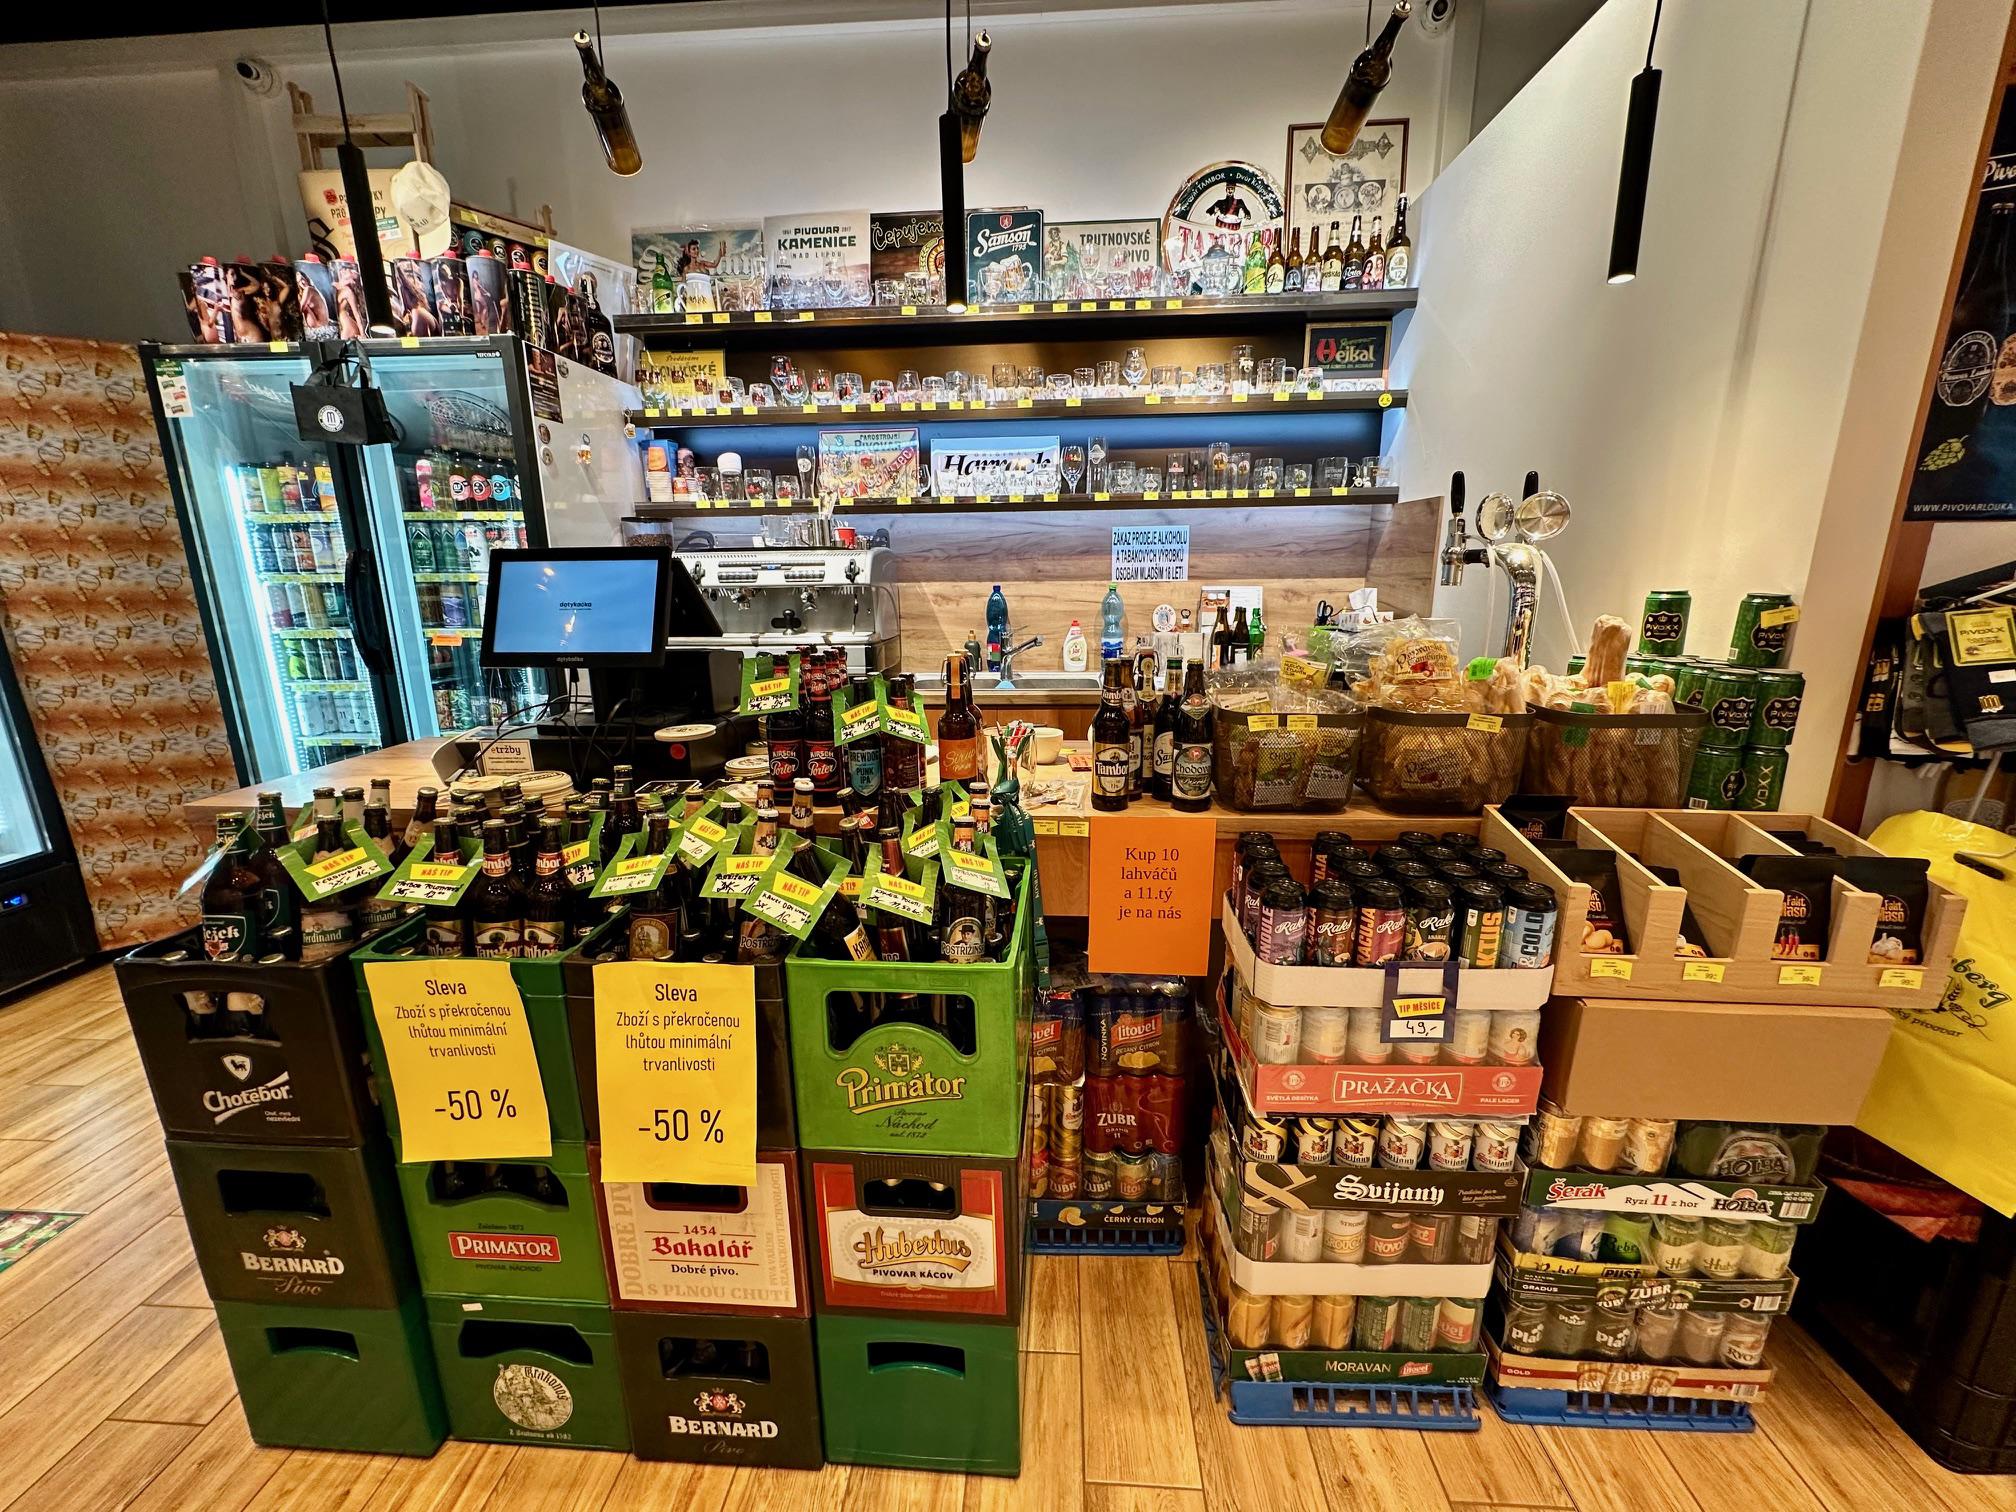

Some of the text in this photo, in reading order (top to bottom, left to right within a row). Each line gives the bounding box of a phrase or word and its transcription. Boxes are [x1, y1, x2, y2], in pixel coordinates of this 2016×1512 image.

[794, 226, 840, 236] PIVOVAR
[1079, 228, 1152, 246] TRUTNOVSKÉ
[777, 235, 857, 251] KAMENICE
[972, 223, 1037, 258] Samson
[1113, 530, 1188, 546] ZÁKAZ PRODEJE ALKOHOLU
[1121, 548, 1157, 563] TABÁKOVÝCH
[1158, 546, 1184, 562] VÝROBKŮ
[1115, 565, 1139, 581] OSOBÁM
[1139, 563, 1164, 580] MLADŠÍM
[1165, 565, 1172, 580] 18
[490, 744, 521, 756] etržby
[772, 750, 796, 759] KIRSCH
[810, 750, 834, 759] KIRSCH
[770, 758, 798, 776] Porter
[807, 758, 836, 777] Porter
[856, 767, 874, 776] PUNK
[860, 775, 872, 785] IPA
[342, 854, 355, 864] TIP
[960, 857, 985, 868] NÁŠ TIP
[1125, 846, 1180, 864] Kup 10
[420, 867, 454, 877] NÁŠ TIP
[735, 859, 763, 869] NÁŠ TIP
[1120, 865, 1178, 881] lahváčů
[781, 881, 811, 897] NÁŠ TIP
[888, 880, 916, 892] NÁŠ TIP
[1124, 886, 1173, 904] a 11.tý
[1786, 894, 1806, 907] Fakt
[1117, 905, 1182, 921] je na nás
[425, 979, 467, 997] Sleva
[654, 983, 698, 1003] Sleva
[395, 1002, 512, 1023] Zboží s překročenou
[1399, 1001, 1441, 1014] TIP MĚSÍCE
[616, 1010, 740, 1032] Zboží s překročenou
[1117, 1017, 1156, 1041] Litovel
[408, 1021, 508, 1040] lhůtou minimální
[625, 1032, 733, 1050] lhůtou minimální
[1100, 1018, 1108, 1061] NOVINKA
[429, 1042, 497, 1058] trvanlivosti
[643, 1057, 716, 1072] trvanlivosti
[835, 1066, 968, 1108] Primátor
[1340, 1077, 1453, 1100] PRAŽAČKA
[434, 1088, 517, 1121] -50 %
[1497, 1096, 1520, 1104] LAGER
[638, 1108, 724, 1144] -50 %
[1097, 1112, 1137, 1127] ZUBR
[1717, 1155, 1788, 1176] HOLBA
[1333, 1173, 1445, 1207] Svijany
[1545, 1178, 1609, 1202] Šerák
[1652, 1194, 1668, 1206] 11
[1678, 1198, 1699, 1208] hor
[1711, 1197, 1772, 1215] HOLBA
[1104, 1214, 1165, 1224] ČERNÝ CITRON
[682, 1225, 717, 1236] 1454
[651, 1235, 754, 1260] Bakalář
[852, 1225, 972, 1264] Hubertus
[240, 1251, 345, 1276] BERNARD
[671, 1264, 739, 1277] Dobré pivo.
[872, 1268, 954, 1280] PIVOVAR KÁCOV
[647, 1283, 791, 1302] S PLNOU CHUTÍ
[1522, 1284, 1559, 1292] GRADUS
[1629, 1283, 1672, 1301] ZUBR
[1325, 1359, 1392, 1373] MORAVAN
[1506, 1368, 1531, 1376] GOLD
[668, 1415, 779, 1438] BERNARD
